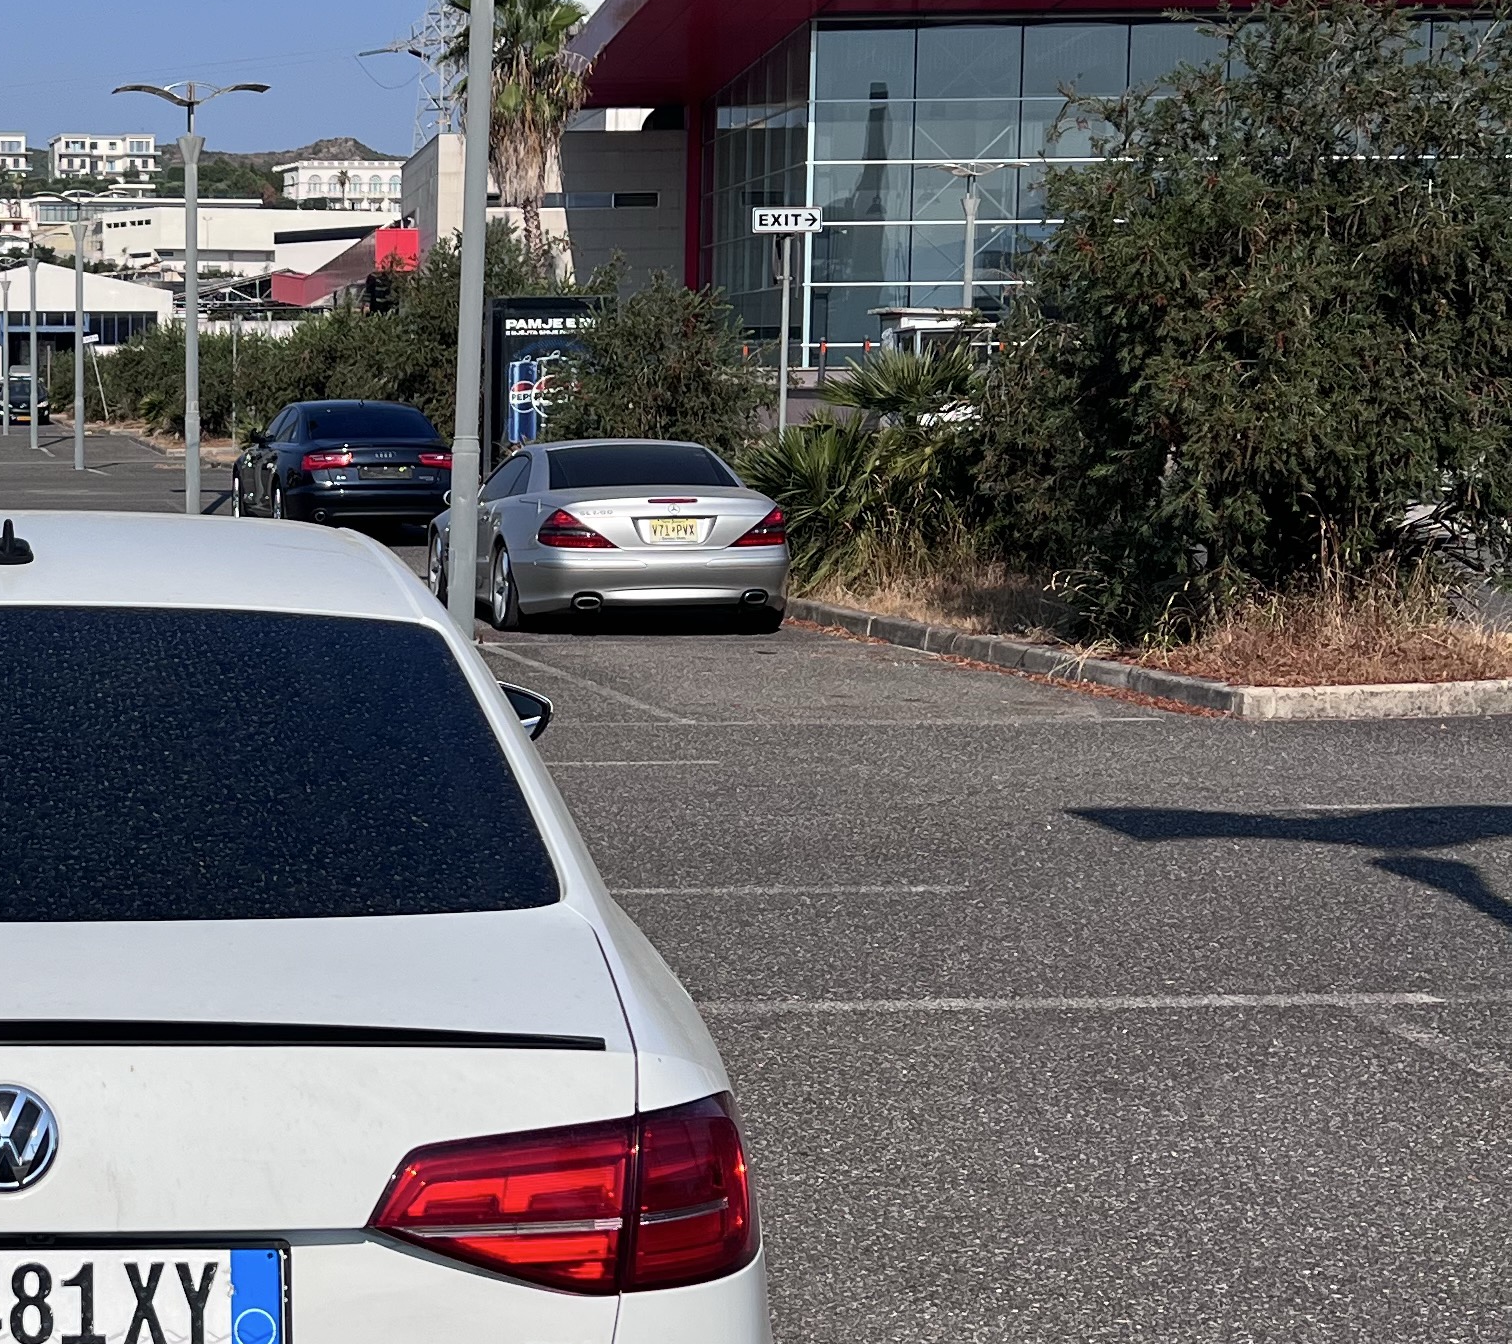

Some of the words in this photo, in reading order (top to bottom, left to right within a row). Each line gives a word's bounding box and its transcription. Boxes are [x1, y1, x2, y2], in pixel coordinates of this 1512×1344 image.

[758, 213, 802, 227] EXIT
[505, 317, 564, 330] PAMJE
[566, 317, 577, 329] E
